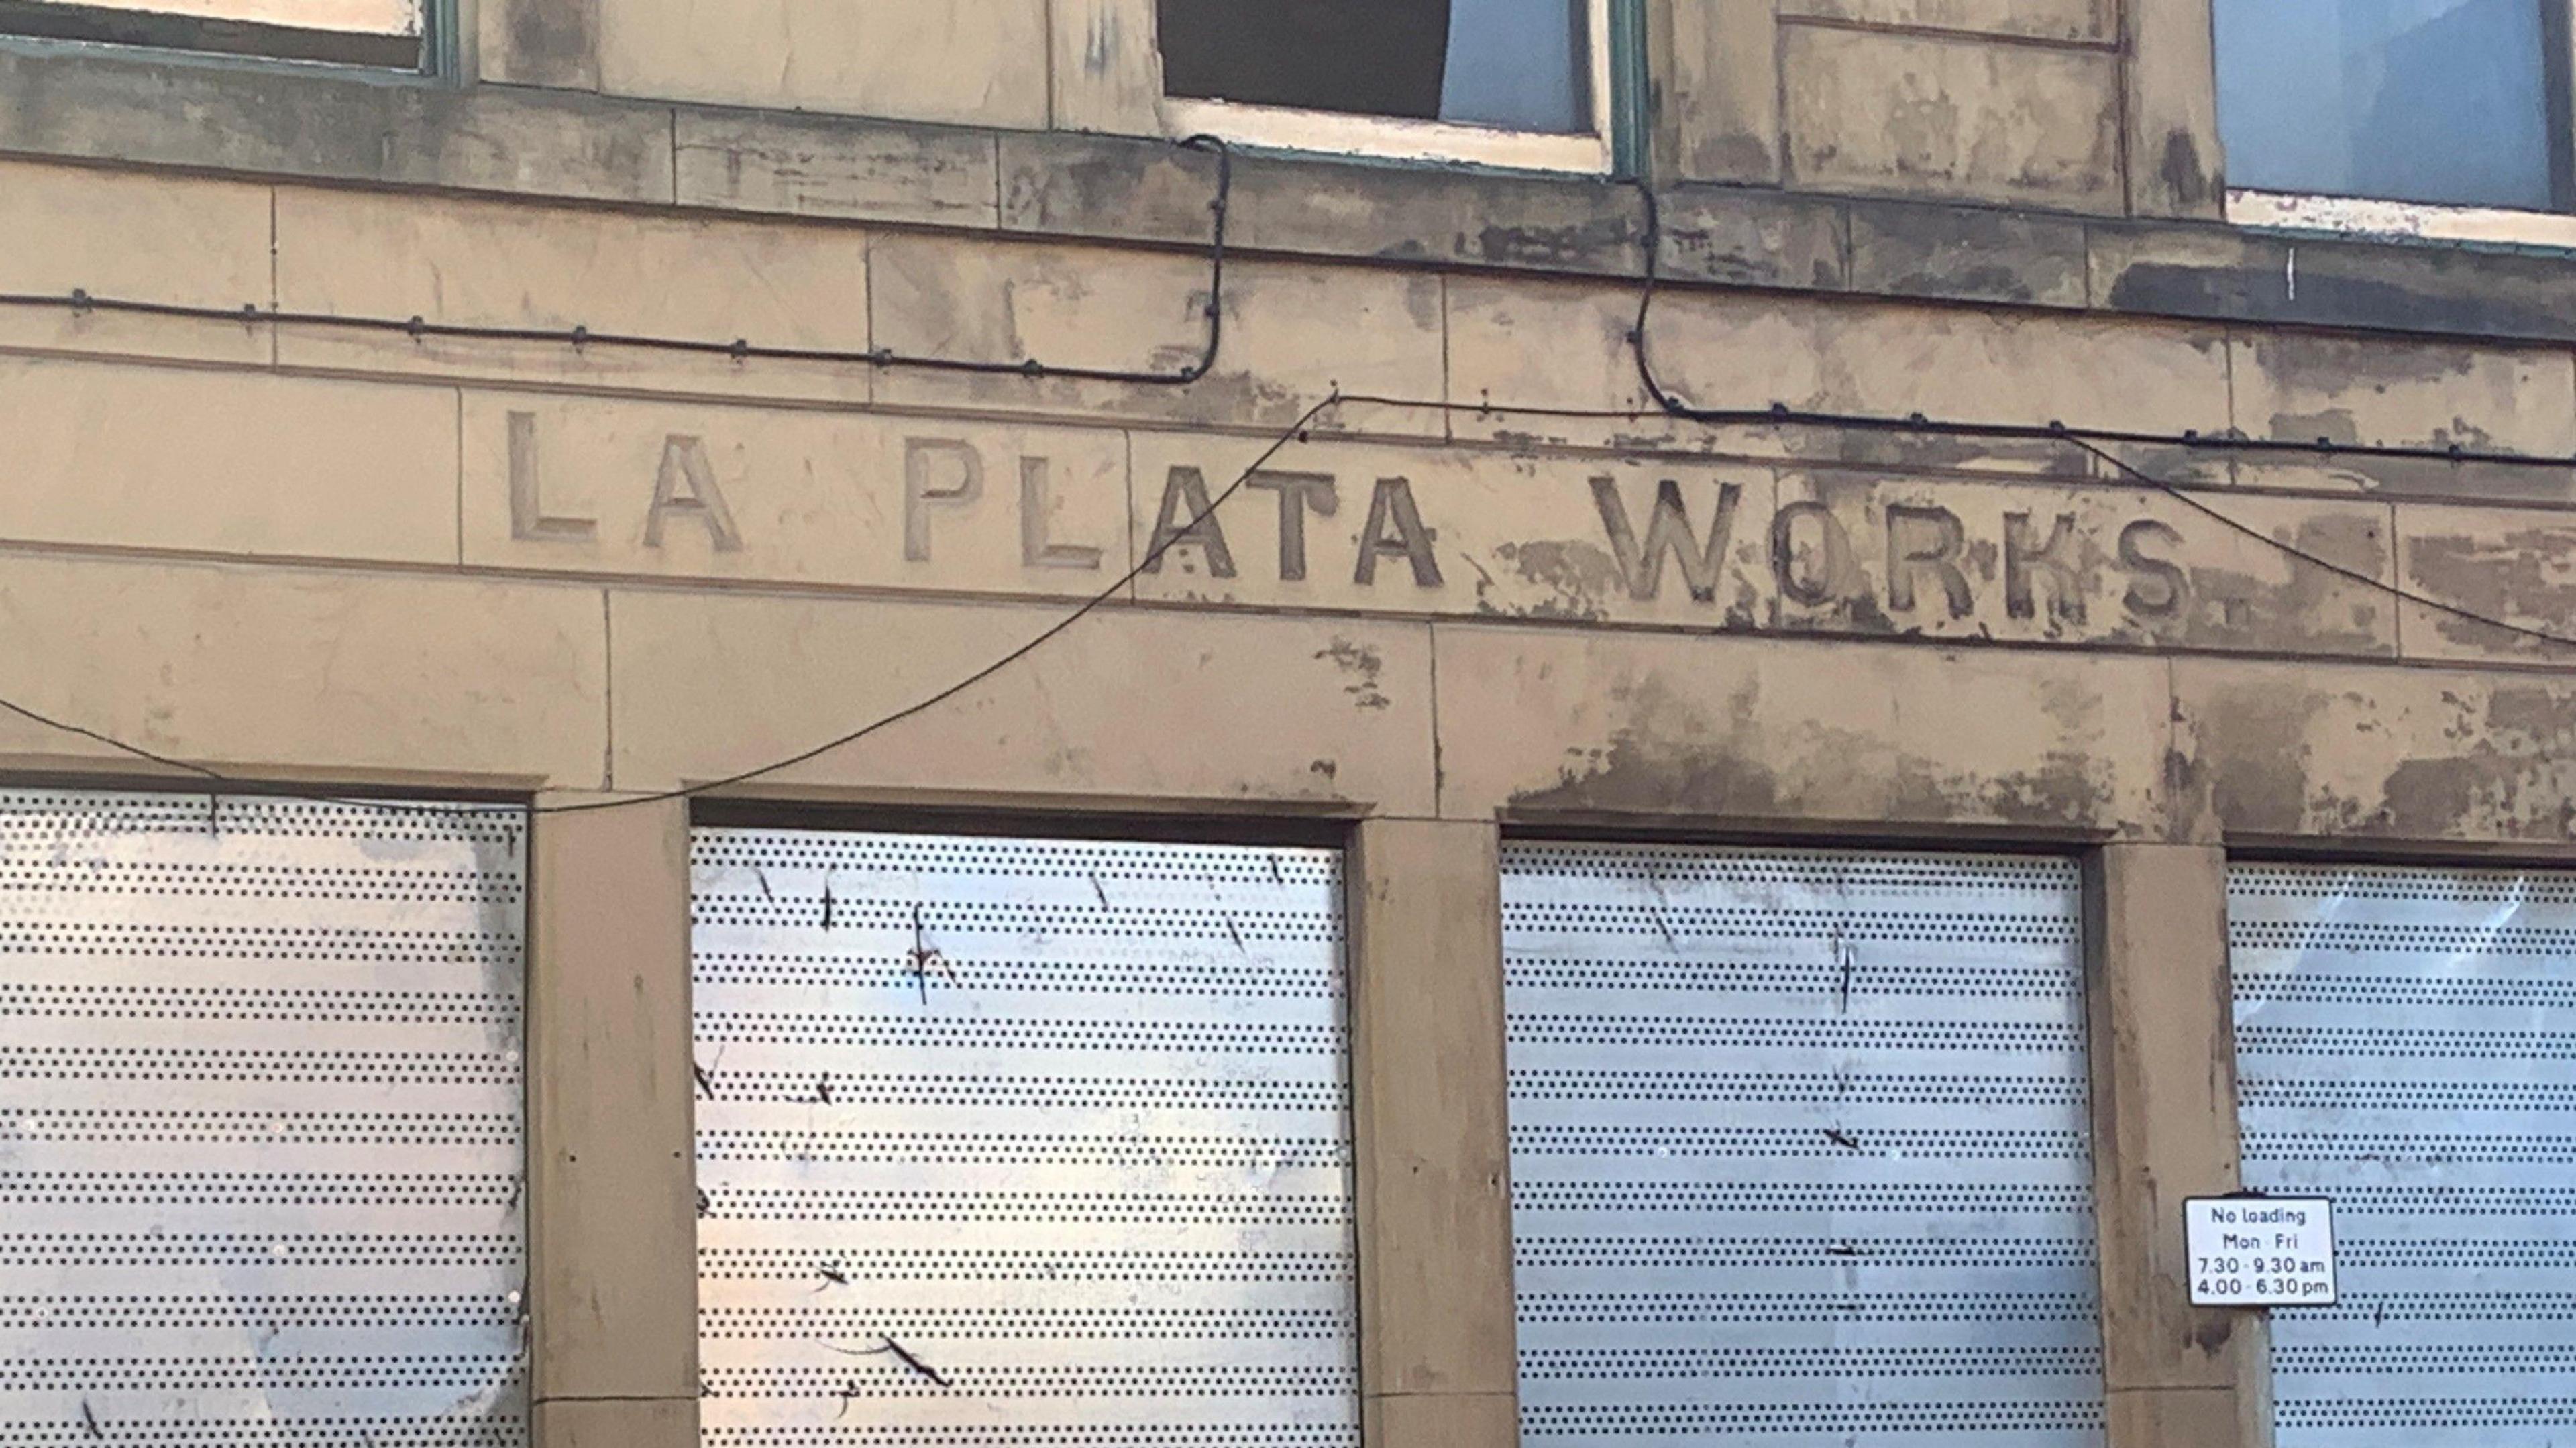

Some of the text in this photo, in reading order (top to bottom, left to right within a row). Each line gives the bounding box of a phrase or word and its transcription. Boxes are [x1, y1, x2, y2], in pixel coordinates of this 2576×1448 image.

[507, 410, 743, 552] LA
[903, 435, 1443, 588] PLATA
[2212, 1208, 2306, 1226] No loading
[2223, 1234, 2261, 1249] Mon
[2275, 1234, 2298, 1249] Fri
[2198, 1257, 2239, 1274] 7.30
[2253, 1257, 2296, 1274] 9.30
[2300, 1260, 2325, 1272] am
[2197, 1279, 2243, 1295] 4.00
[2256, 1278, 2298, 1295] 6.30
[2302, 1282, 2329, 1296] pm
